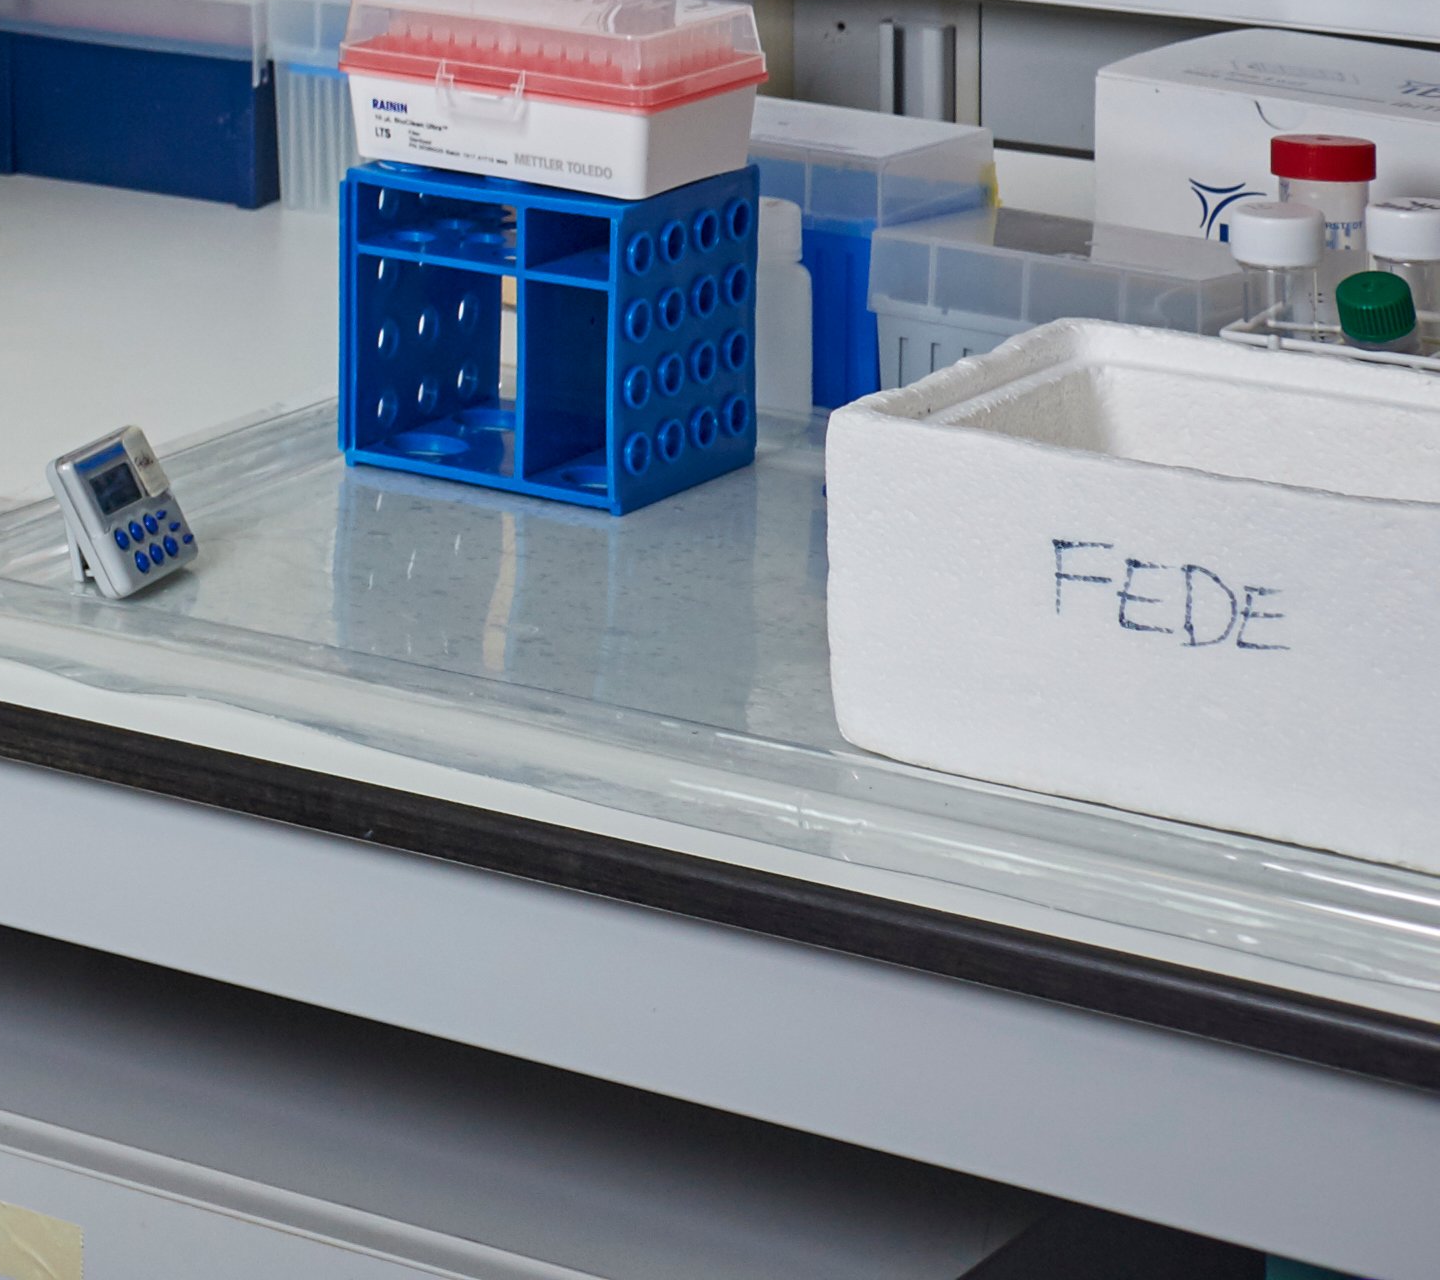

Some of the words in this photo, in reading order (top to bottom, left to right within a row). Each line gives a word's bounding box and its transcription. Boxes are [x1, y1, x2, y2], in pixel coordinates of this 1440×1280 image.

[371, 97, 408, 115] RAININ
[375, 127, 392, 140] LTS
[514, 152, 564, 172] METTLER
[566, 160, 614, 181] TOLEDO
[1050, 536, 1291, 652] FEDE
